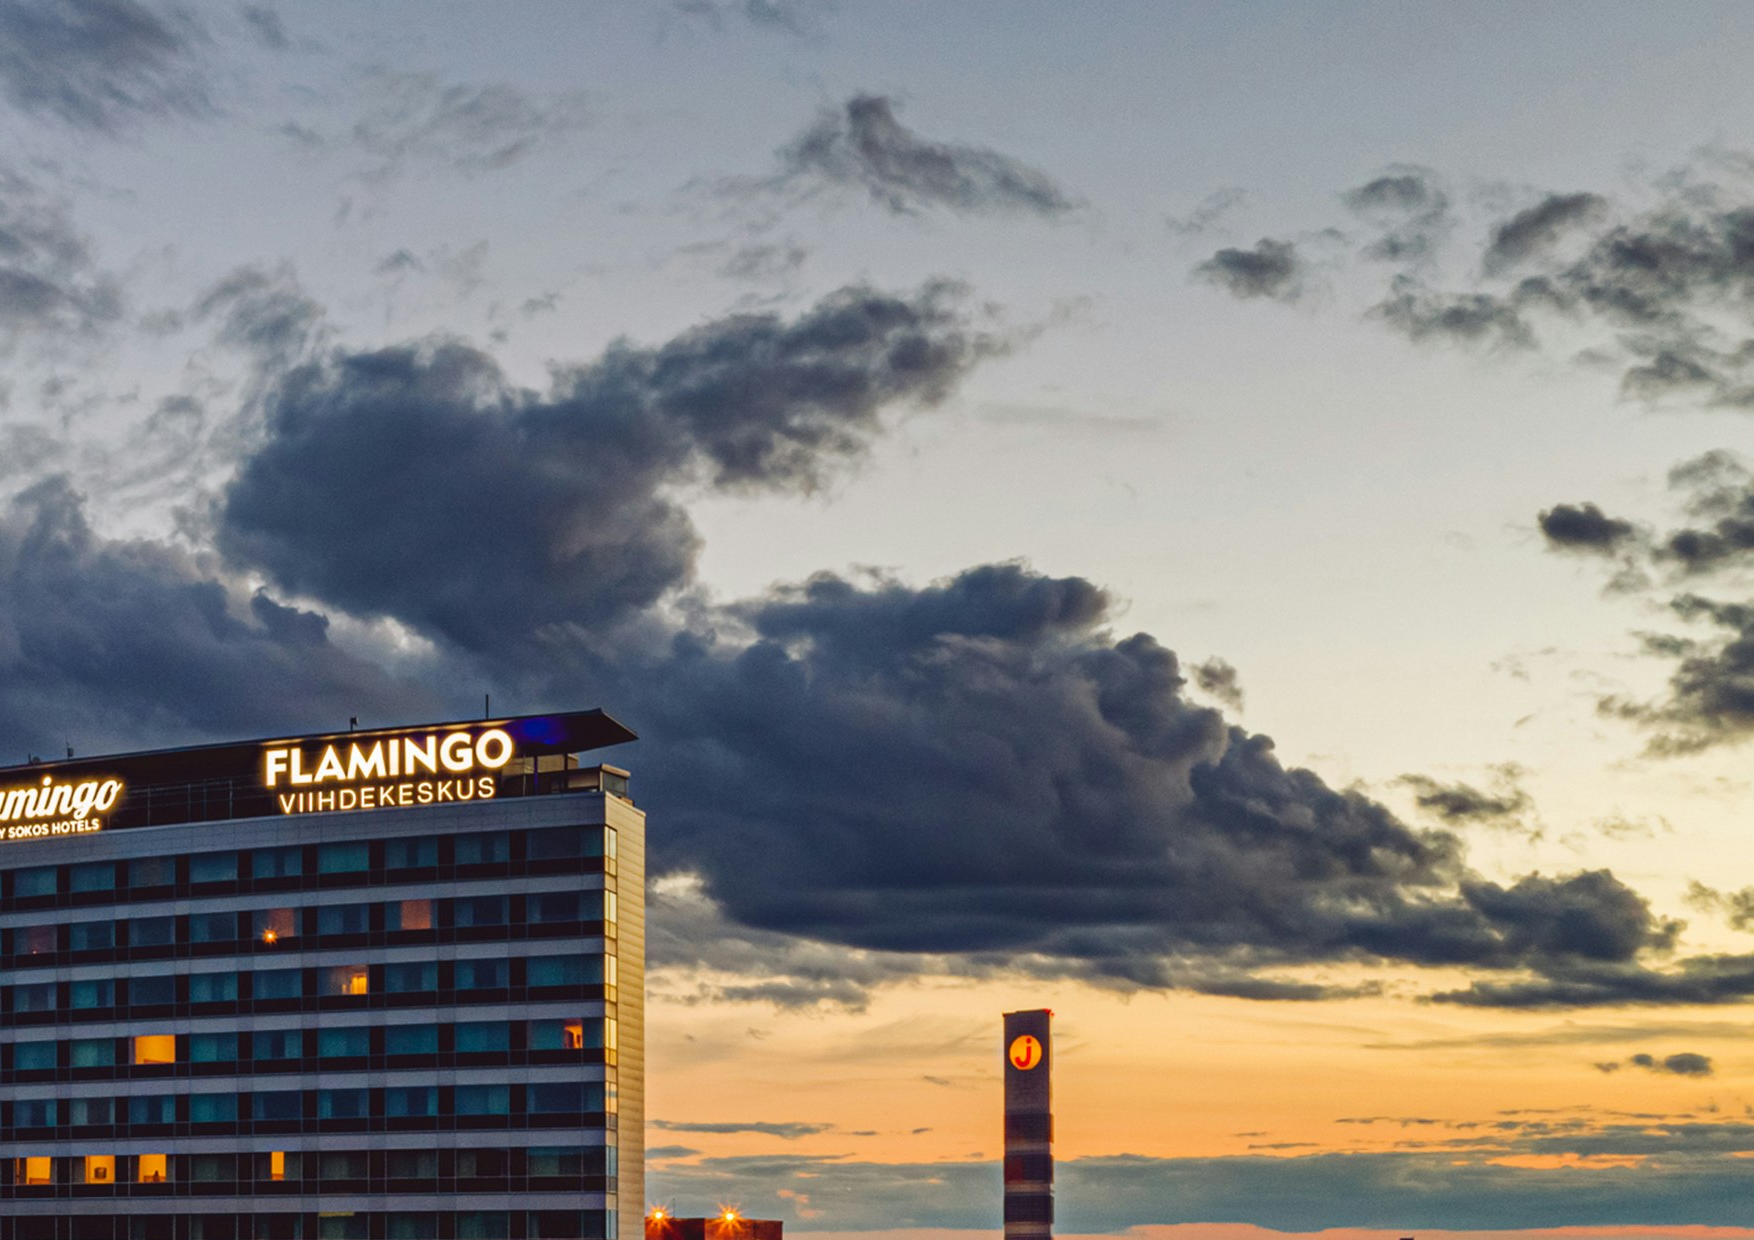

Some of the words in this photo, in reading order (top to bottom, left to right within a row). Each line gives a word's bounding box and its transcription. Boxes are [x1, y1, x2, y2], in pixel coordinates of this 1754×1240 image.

[265, 728, 513, 787] FLAMINGO
[280, 777, 495, 815] VIIHDEKESKUS
[8, 823, 49, 840] SOKOS
[51, 818, 100, 834] HOTELS
